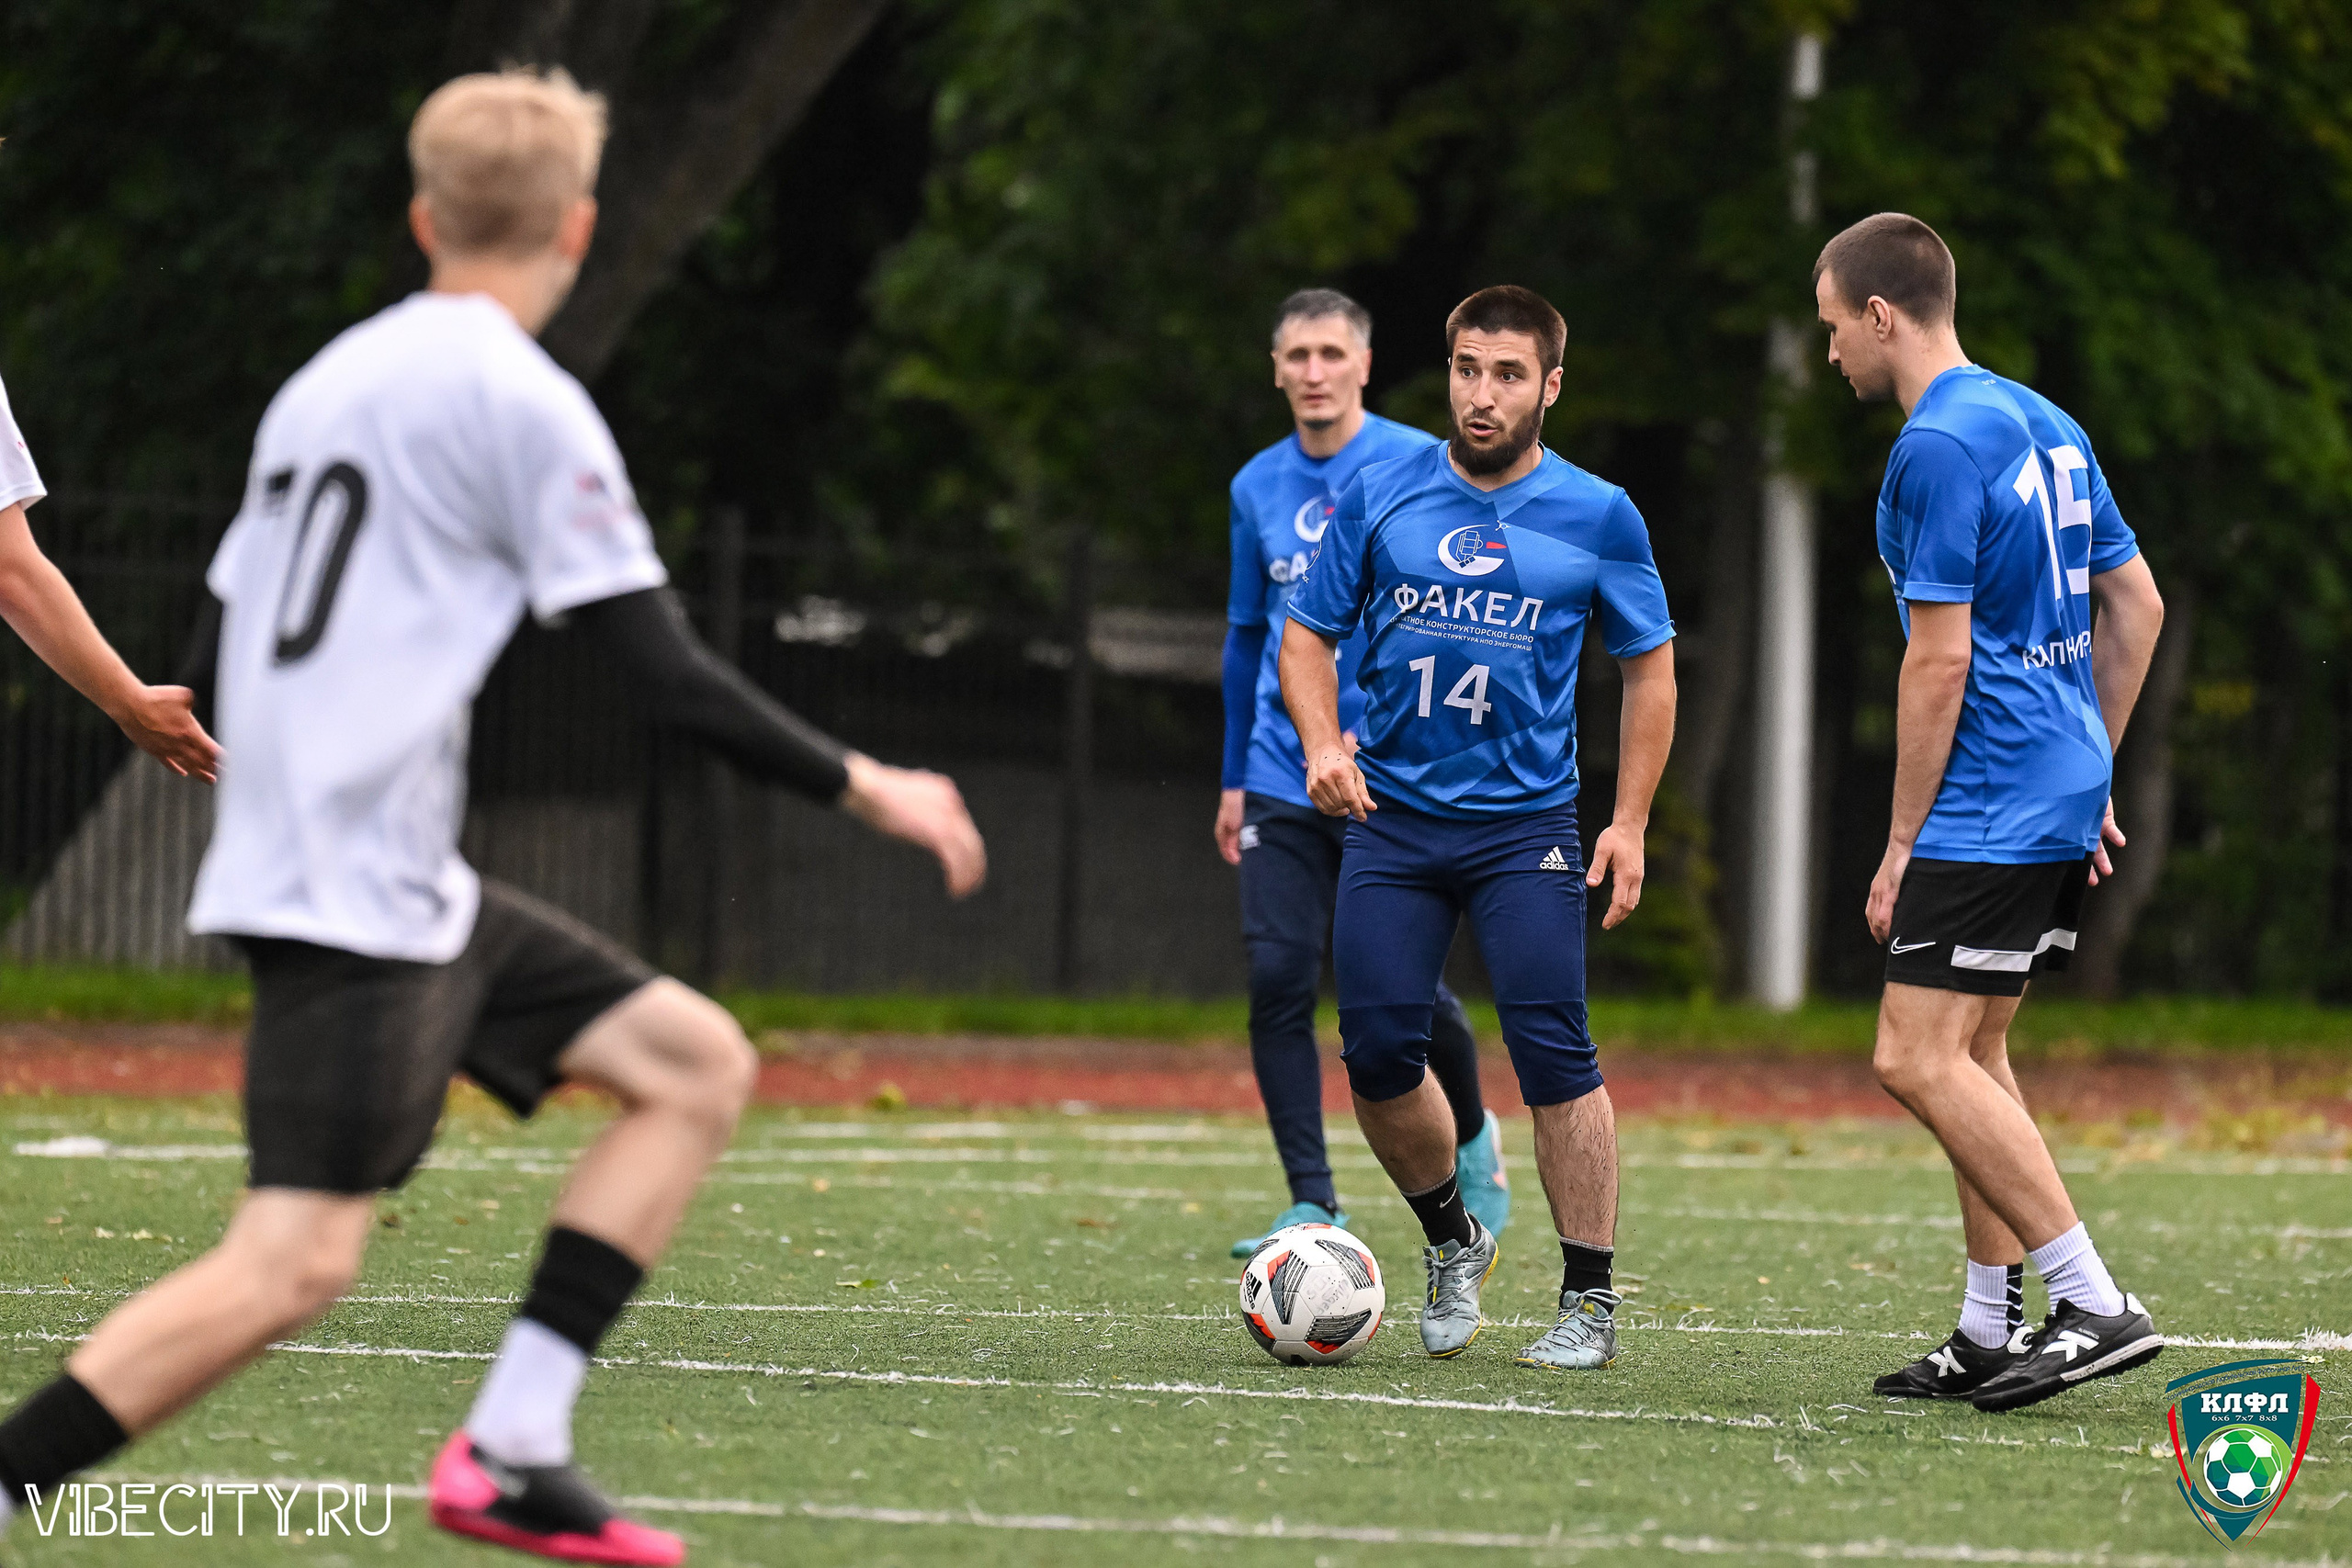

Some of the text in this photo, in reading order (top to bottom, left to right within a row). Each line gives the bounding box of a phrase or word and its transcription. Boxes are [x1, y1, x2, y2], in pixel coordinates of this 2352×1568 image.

[2013, 445, 2092, 601] 15
[1394, 583, 1544, 630] ФАКЕЛ
[1426, 620, 1508, 639] КОНСТРУКТОРСКОЕ
[1510, 633, 1534, 643] БЮРО
[1442, 632, 1478, 643] СТРУКТУРА
[1408, 655, 1492, 726] 14
[1539, 861, 1569, 871] adidas
[1245, 1271, 1255, 1310] adidas
